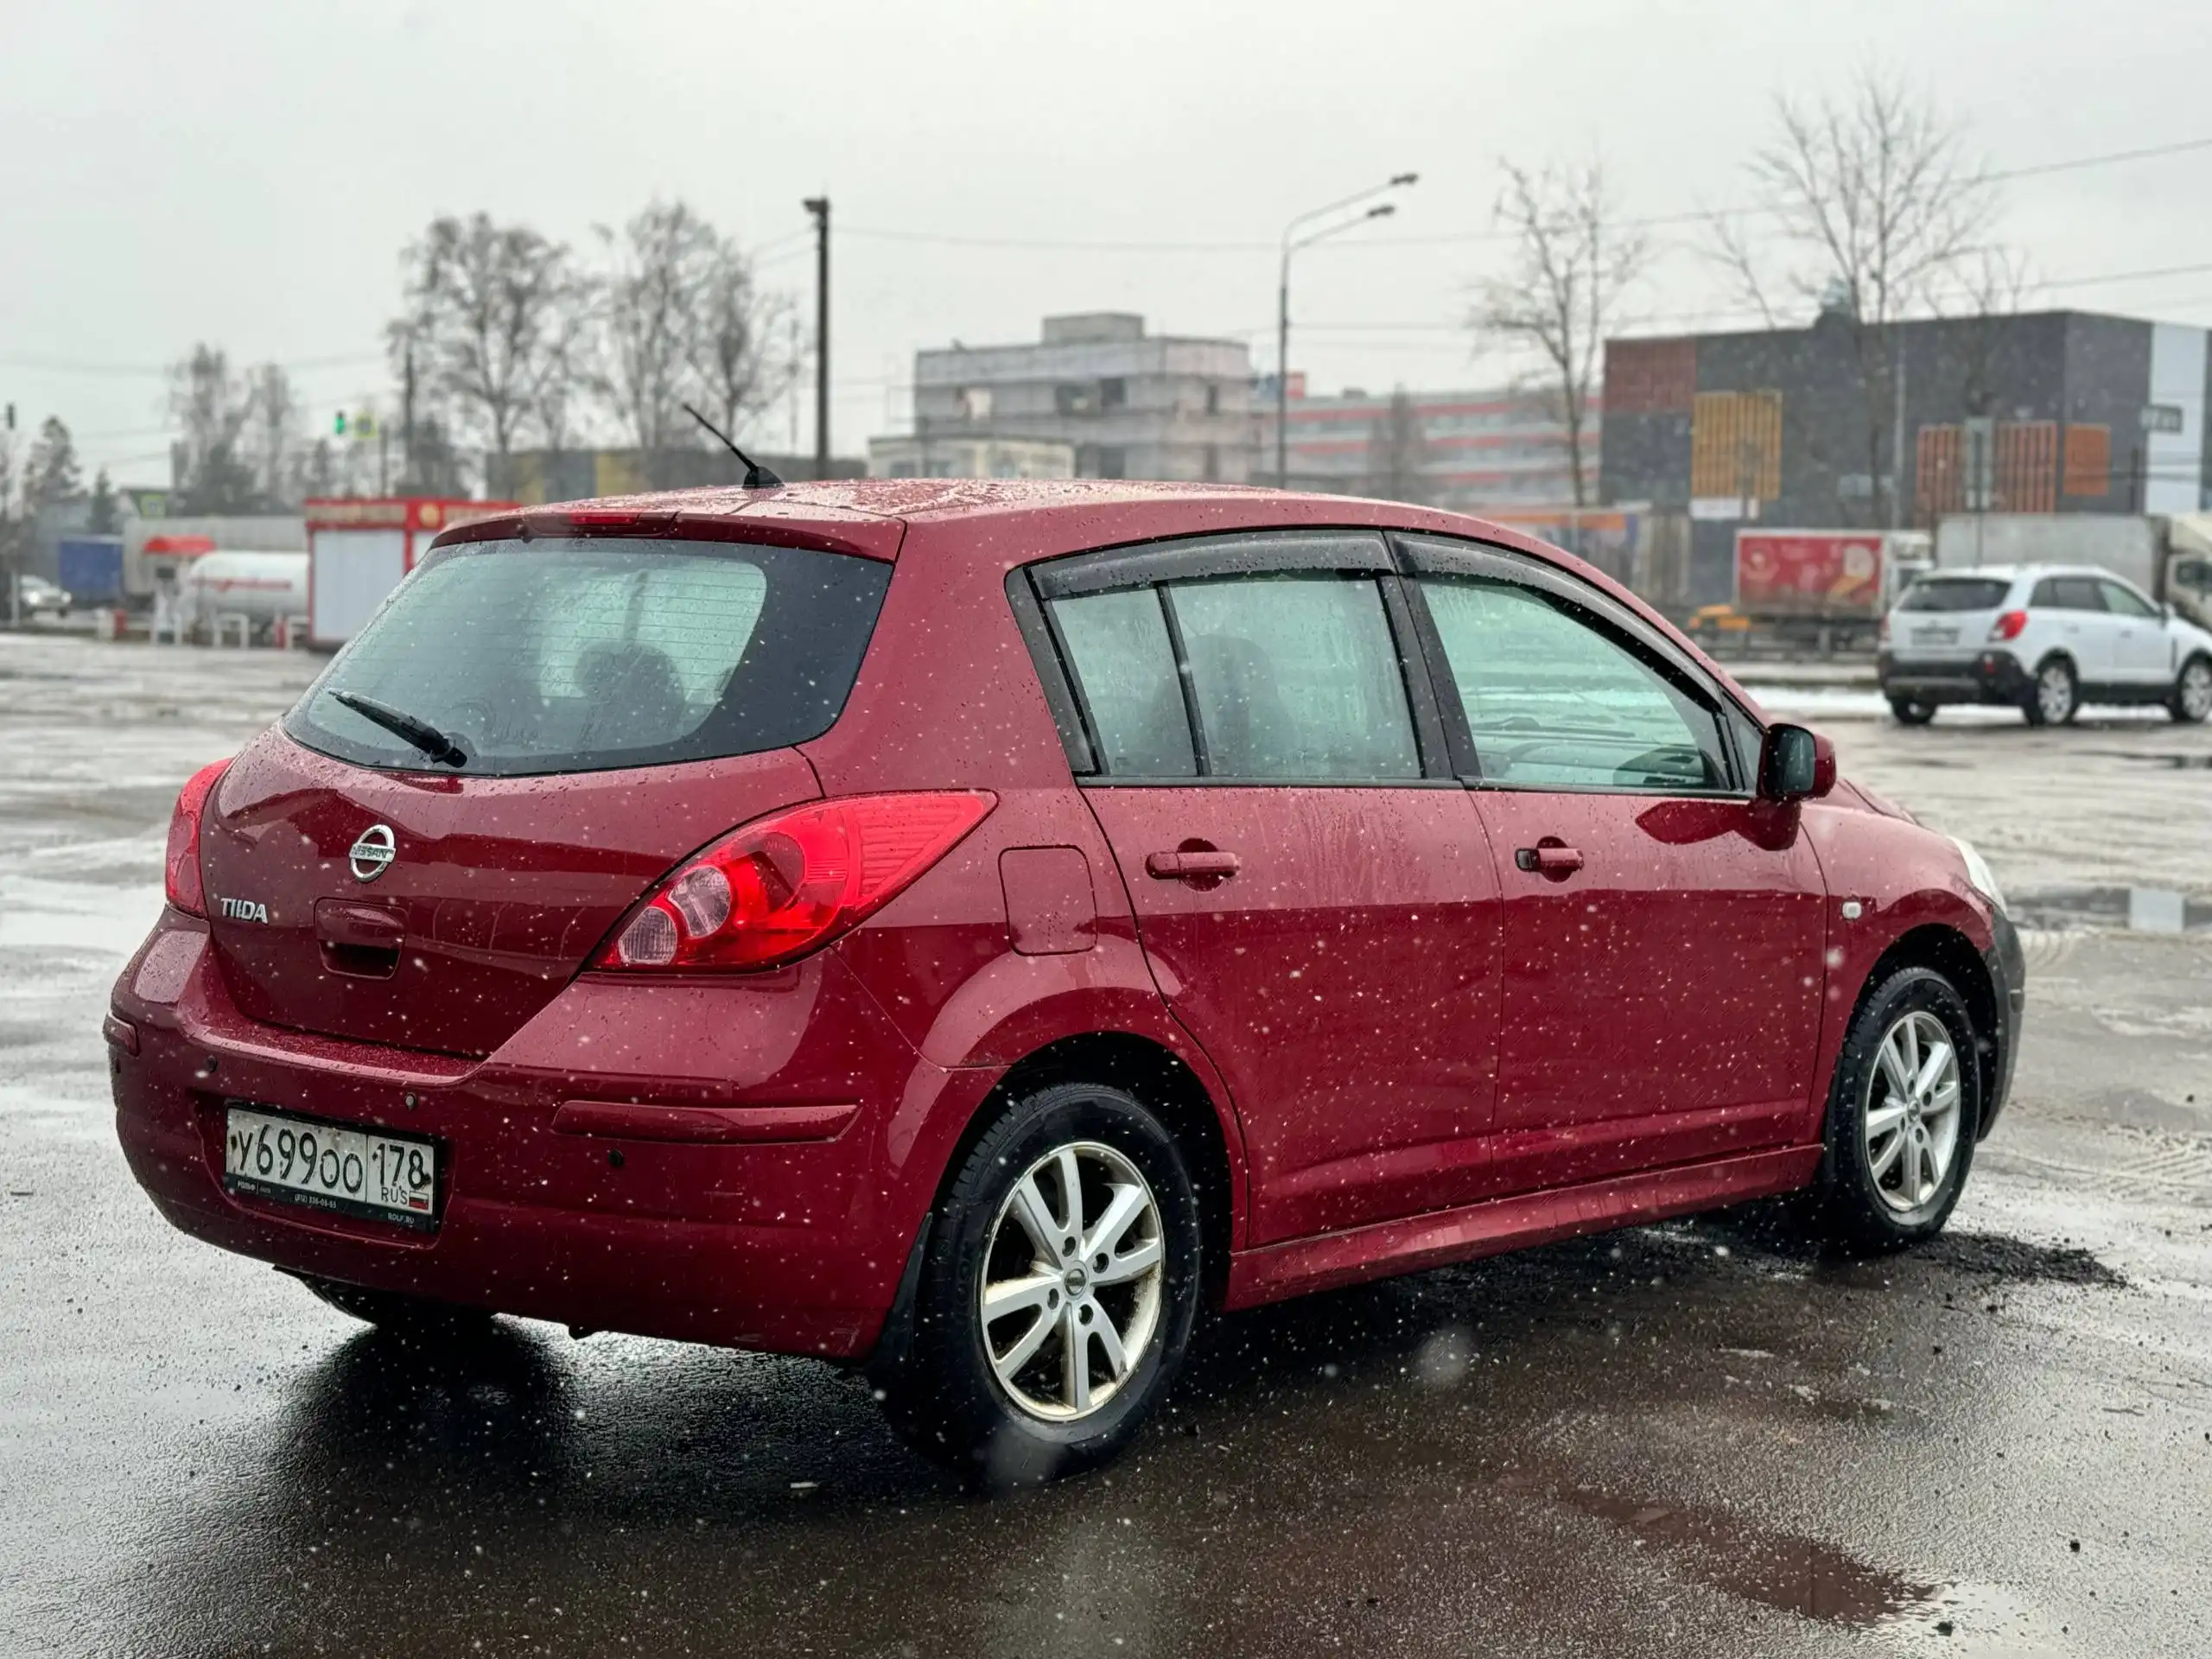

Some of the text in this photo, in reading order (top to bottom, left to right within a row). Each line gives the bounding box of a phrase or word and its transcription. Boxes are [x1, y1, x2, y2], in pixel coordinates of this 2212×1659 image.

[352, 846, 390, 859] NISSAN
[221, 898, 269, 924] TIIDA
[373, 1142, 425, 1190] 178
[380, 1186, 408, 1205] RUS
